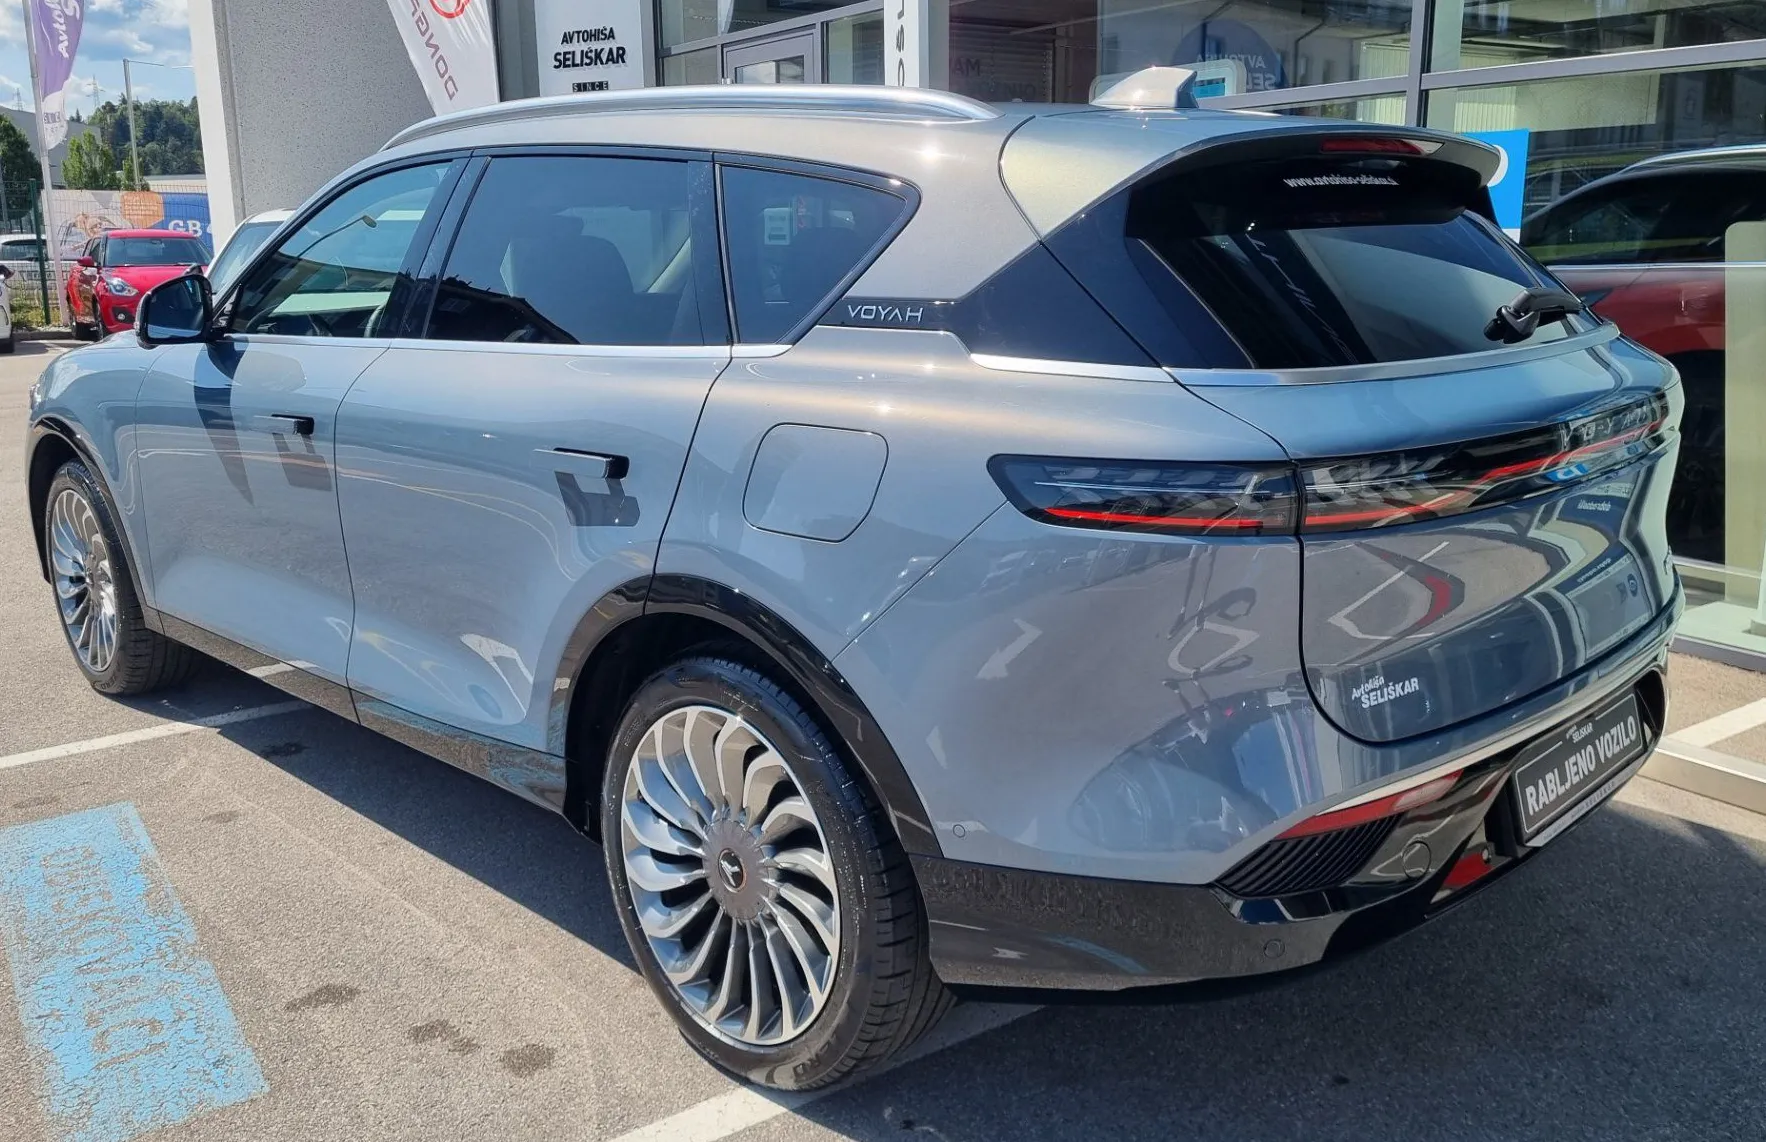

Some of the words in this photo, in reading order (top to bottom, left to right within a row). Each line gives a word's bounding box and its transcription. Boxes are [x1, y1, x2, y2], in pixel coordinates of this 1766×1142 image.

[561, 26, 616, 45] AVTOHIŠA
[553, 46, 627, 70] SELIŠKAR
[573, 81, 608, 92] SINCE
[847, 304, 924, 324] VOYAH
[1361, 677, 1419, 709] SELIŠKAR
[1525, 744, 1596, 816] RABLJENO
[1595, 715, 1637, 763] VOZILO
